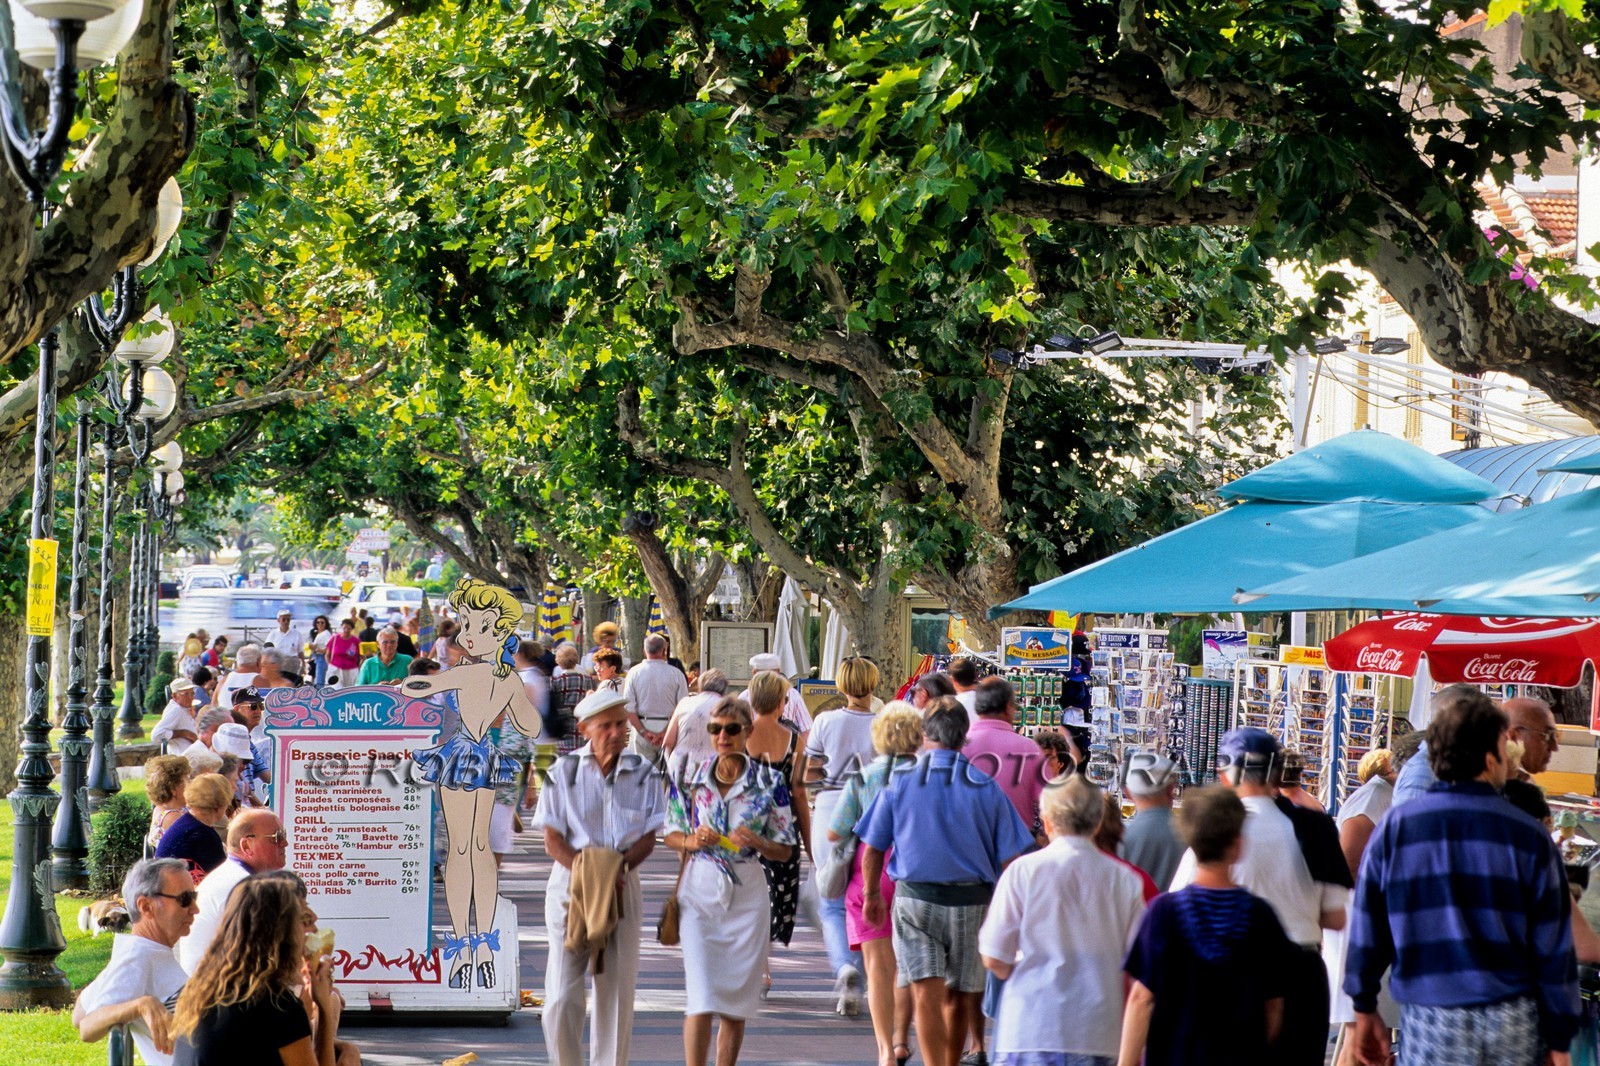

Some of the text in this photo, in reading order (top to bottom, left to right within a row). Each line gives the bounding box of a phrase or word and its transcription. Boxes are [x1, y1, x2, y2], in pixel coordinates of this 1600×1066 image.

[1012, 649, 1062, 658] POSTE MESSAGE
[1357, 646, 1404, 671] Coca-Cola
[1463, 658, 1540, 682] Coca-Cola
[291, 748, 413, 761] Brasserie-Snack
[295, 787, 328, 795] Moules
[332, 786, 383, 795] marinières
[295, 795, 333, 803] Salades
[337, 795, 391, 804] composées
[295, 804, 346, 813] Spaghettis
[350, 804, 401, 813] bolognaise
[294, 816, 326, 825] GRILL
[294, 834, 329, 842] Tartare
[362, 833, 399, 841] Bavette
[293, 842, 340, 850] Entrecôte
[293, 852, 344, 861] TEX'MEX
[293, 861, 313, 869] Chili
[325, 870, 348, 879] pollo
[325, 887, 352, 895] Ribbs
